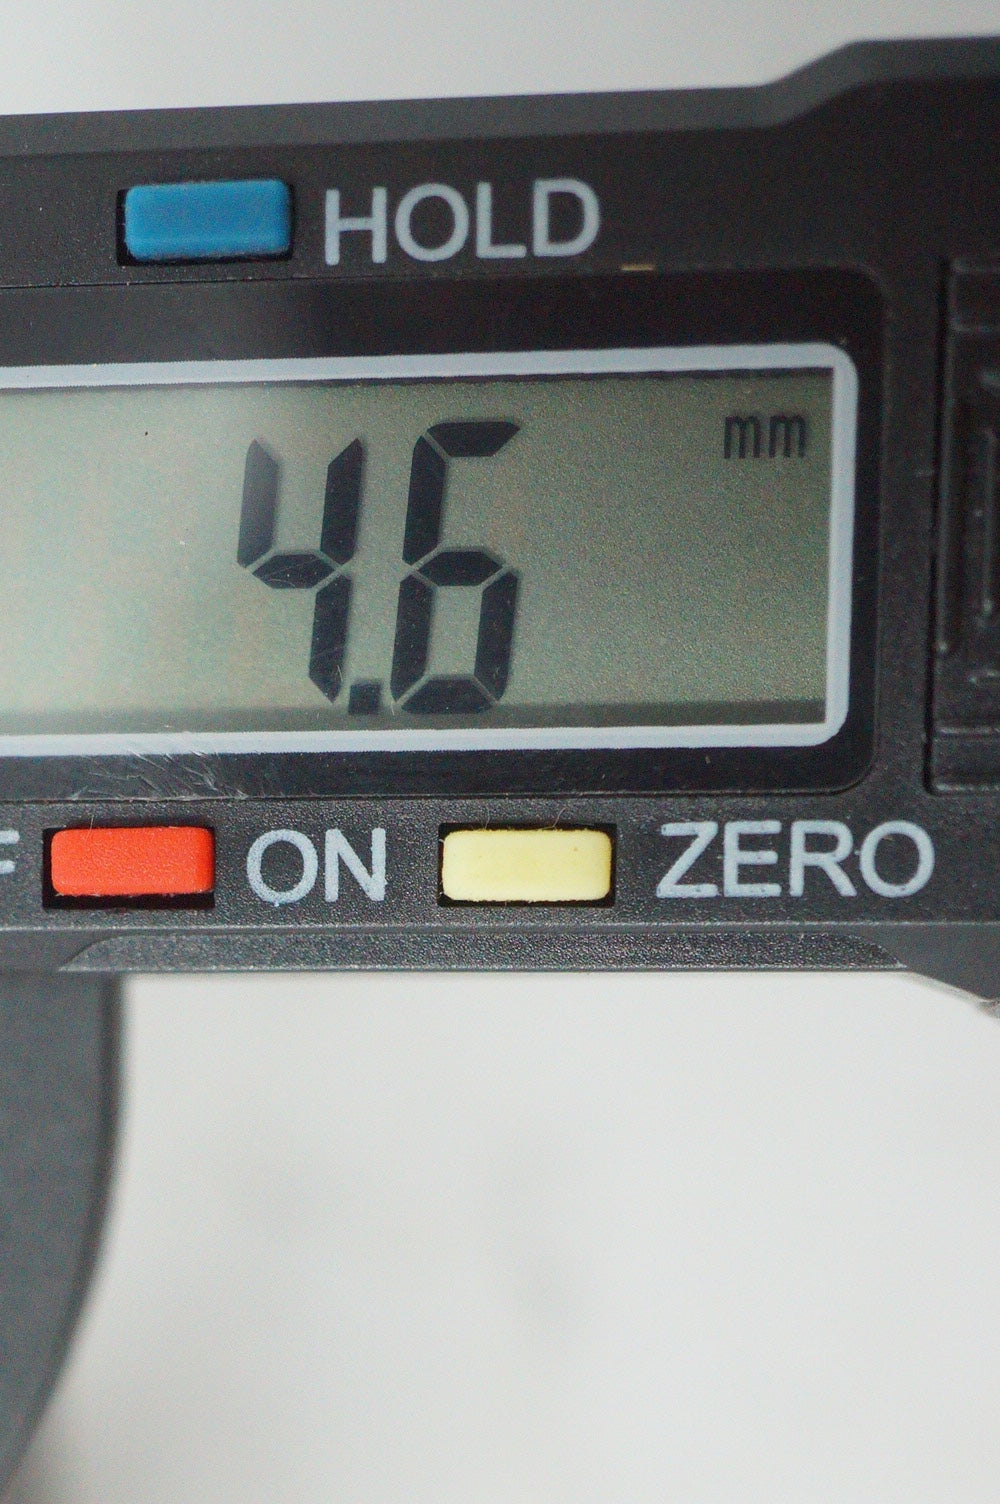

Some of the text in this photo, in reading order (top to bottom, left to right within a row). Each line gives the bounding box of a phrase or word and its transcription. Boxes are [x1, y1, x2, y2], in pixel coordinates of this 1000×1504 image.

[322, 178, 600, 264] HOLD
[236, 411, 808, 716] 4.6 mm
[245, 828, 388, 906] ON
[656, 820, 936, 900] ZERO
